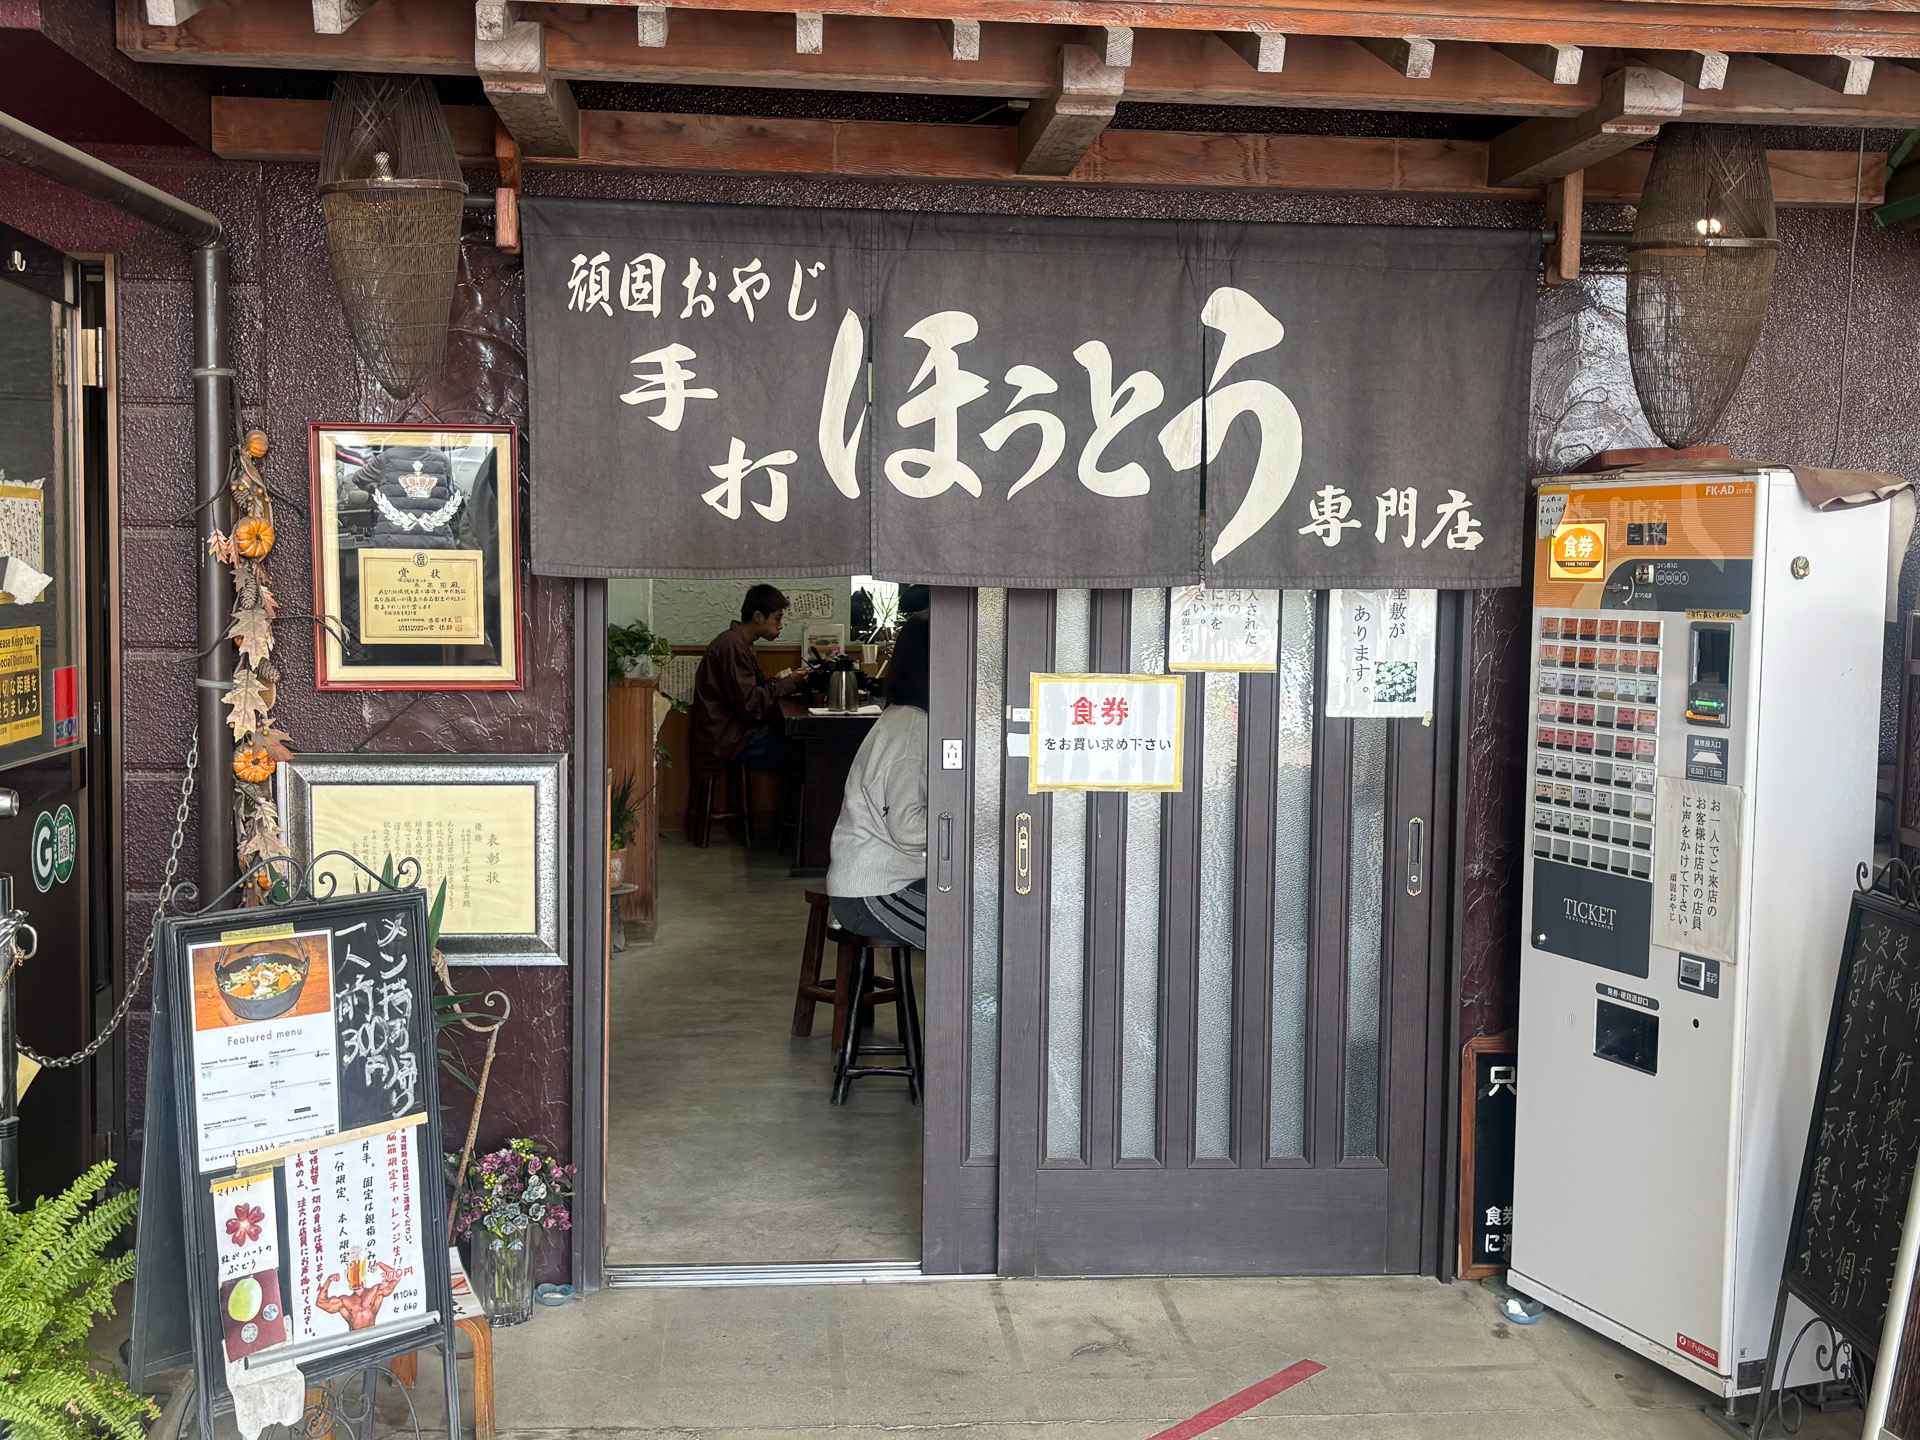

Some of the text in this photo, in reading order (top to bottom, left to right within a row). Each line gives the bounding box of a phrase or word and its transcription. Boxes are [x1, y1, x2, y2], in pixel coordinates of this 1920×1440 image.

[568, 252, 827, 323] 頑固おやじ
[620, 343, 797, 522] 手打
[818, 287, 1302, 564] ほうとう
[1297, 485, 1484, 551] 専門店
[1563, 535, 1593, 558] 食券
[0, 655, 13, 668] ocial
[12, 636, 24, 649] Keep
[1352, 605, 1371, 693] あります。
[1070, 696, 1130, 726] 食券
[1044, 736, 1172, 752] をお買い求め下さい
[486, 833, 501, 884] 表彰状
[1678, 795, 1692, 936] に声をかけて下さい。
[1691, 798, 1706, 931] お客様は店内の店員
[1707, 800, 1721, 917] お一人でご来店の
[1563, 898, 1617, 926] TICKET
[1565, 915, 1614, 931] VENDING MACHINE
[227, 1029, 303, 1046] Featured menu
[381, 1266, 414, 1283] 300円
